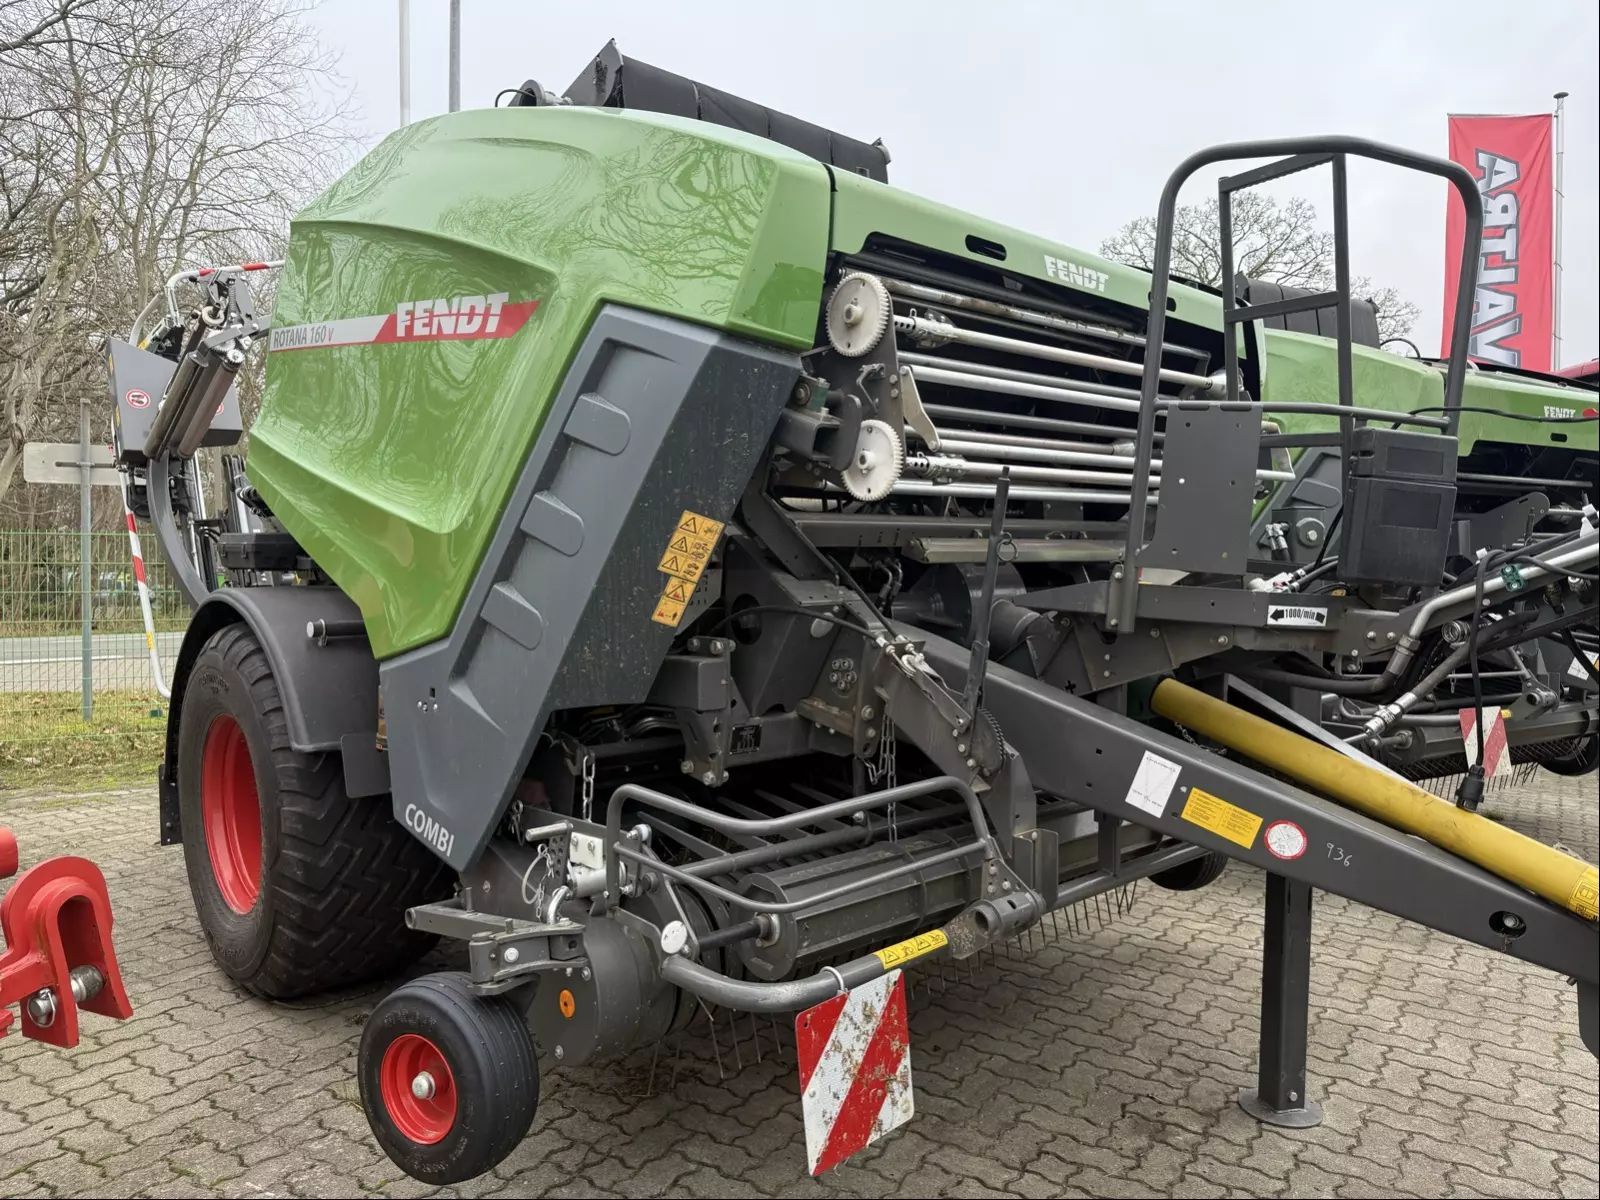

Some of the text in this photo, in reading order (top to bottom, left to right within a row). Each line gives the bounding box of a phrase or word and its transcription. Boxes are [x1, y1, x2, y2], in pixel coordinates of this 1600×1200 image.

[1044, 254, 1109, 292] FENDT
[396, 292, 509, 337] FENDT
[273, 327, 307, 349] ROTANA
[310, 325, 327, 344] 160
[1543, 405, 1576, 419] FENDT
[1285, 608, 1316, 621] 1000/min
[405, 803, 455, 857] COMBI
[1326, 842, 1353, 867] 936
